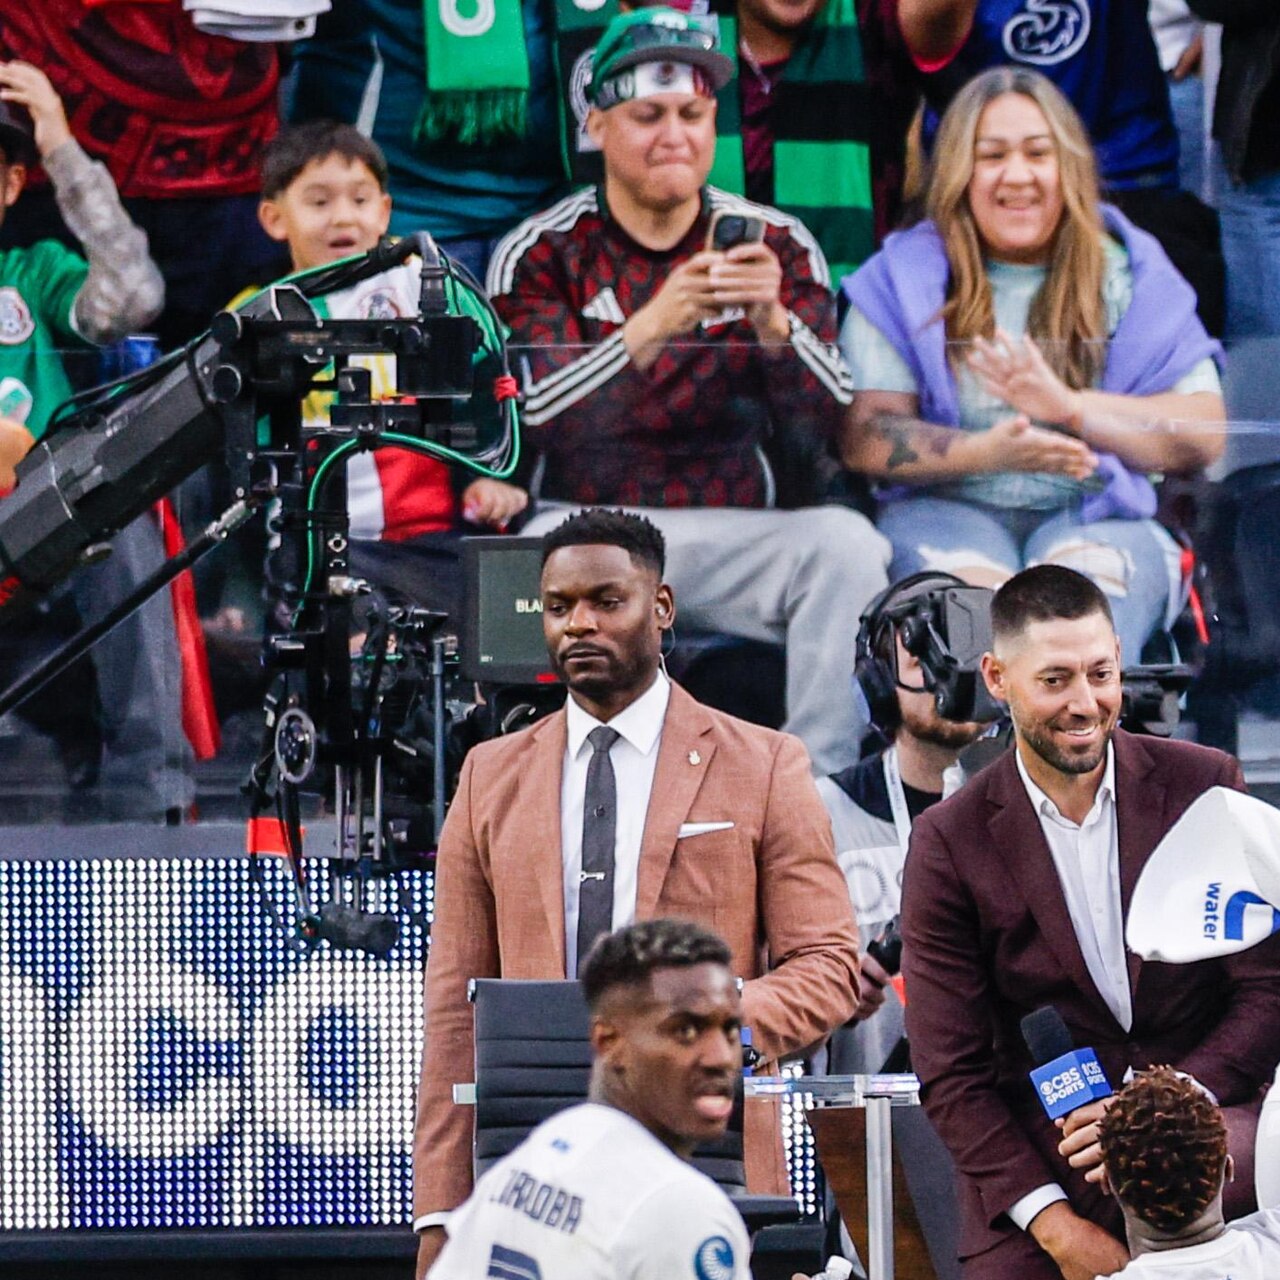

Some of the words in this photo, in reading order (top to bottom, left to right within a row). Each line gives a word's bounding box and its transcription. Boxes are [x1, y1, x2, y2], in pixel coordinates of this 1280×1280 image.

[515, 598, 544, 614] BLA
[1202, 881, 1223, 942] water
[1052, 1068, 1080, 1089] CBS
[1046, 1081, 1085, 1105] SPORTS
